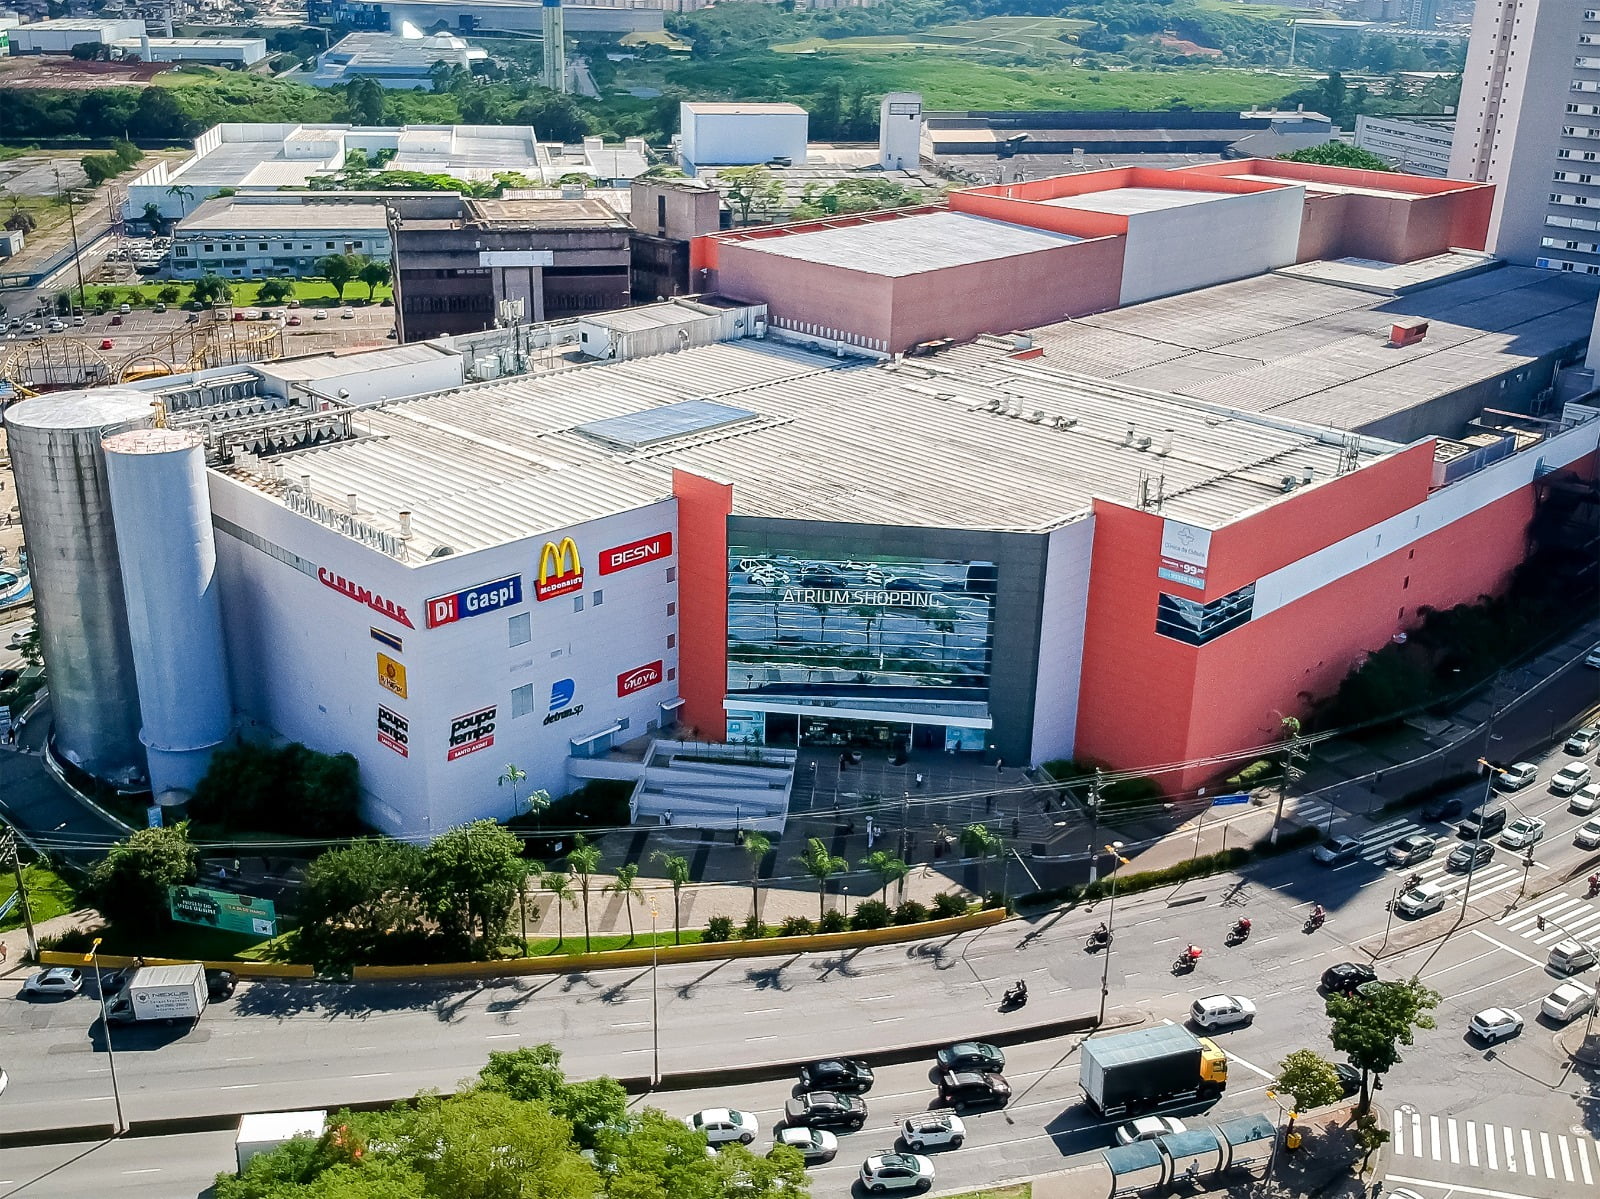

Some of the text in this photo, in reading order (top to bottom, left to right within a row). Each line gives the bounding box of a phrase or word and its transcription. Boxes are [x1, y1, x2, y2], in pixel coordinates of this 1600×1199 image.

[611, 542, 660, 567] BESNI
[318, 567, 415, 630] CINEMARK
[540, 577, 583, 594] McDonald's
[783, 589, 939, 607] ATRIUM SHOPPING
[435, 581, 514, 622] Di Gaspi
[378, 718, 409, 744] tempo
[379, 707, 409, 733] poupa
[451, 709, 496, 738] poupa
[449, 723, 496, 747] tempo
